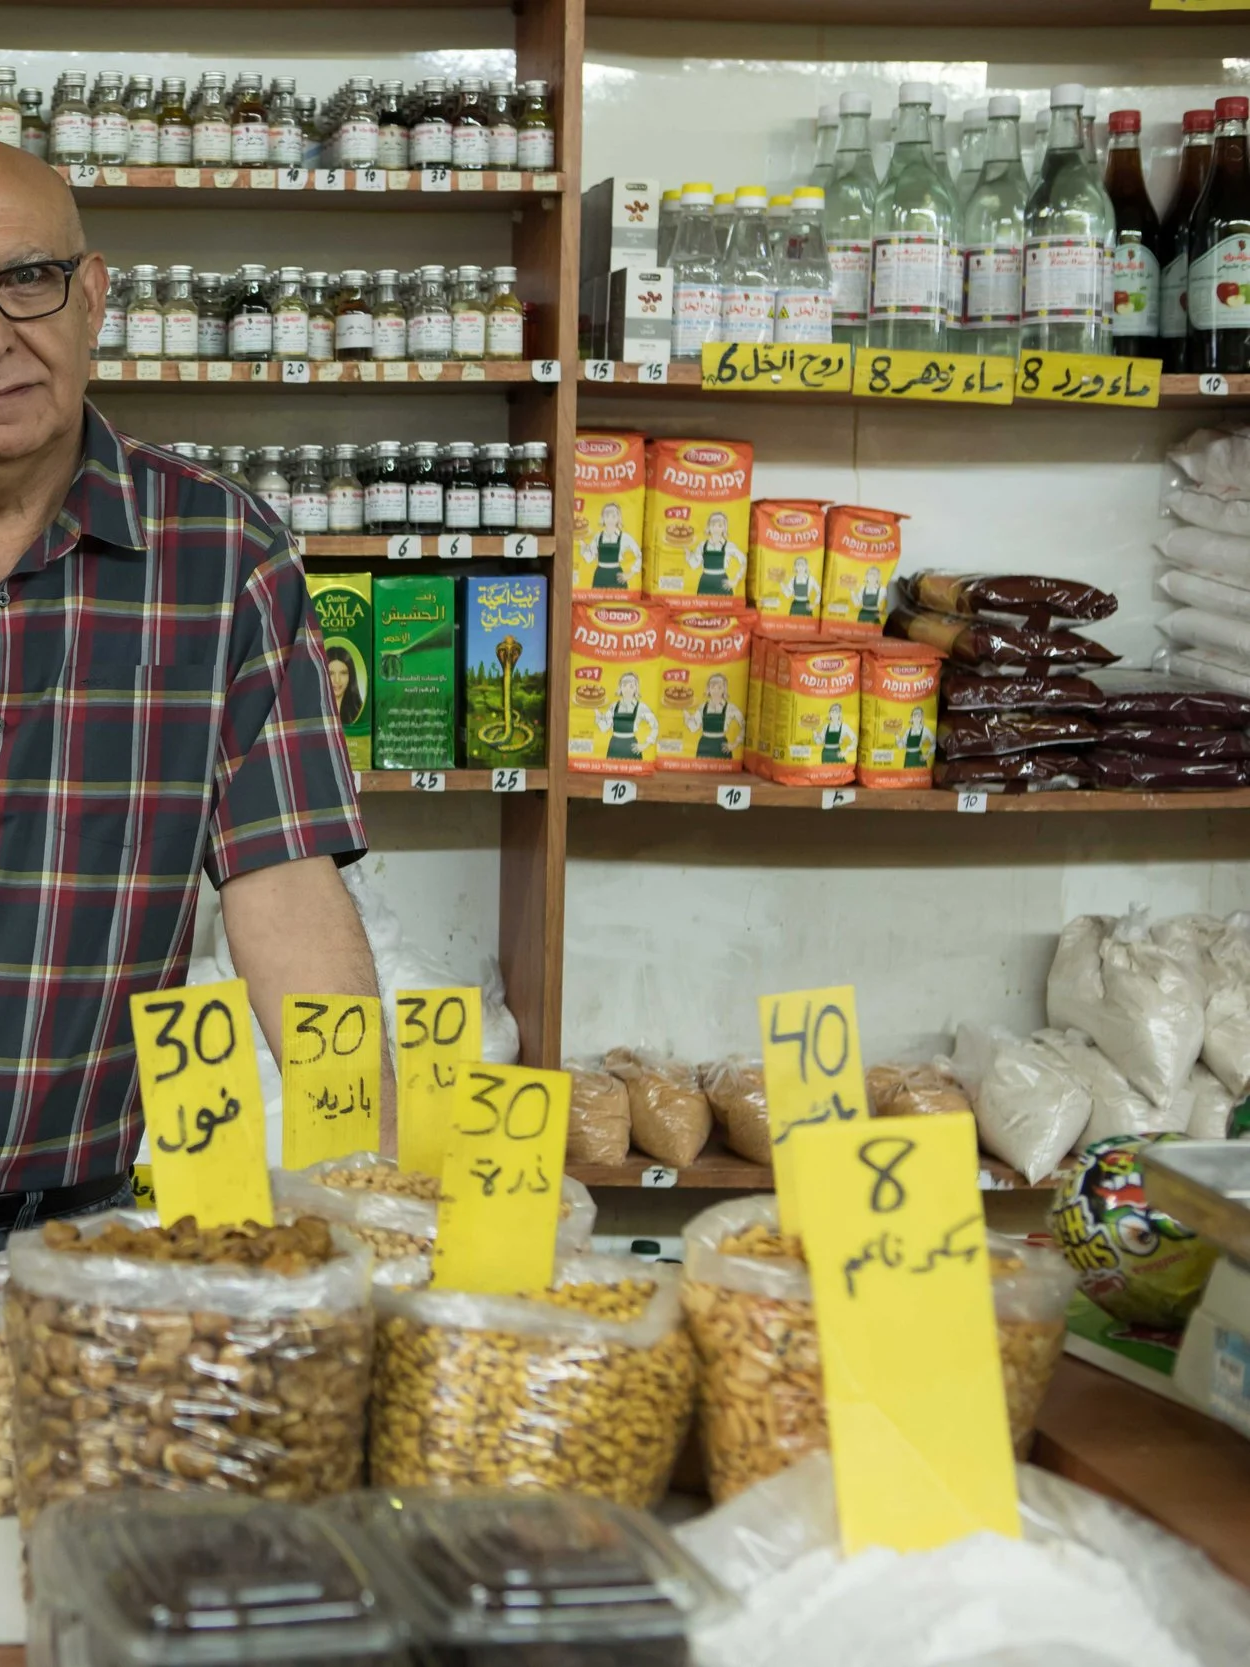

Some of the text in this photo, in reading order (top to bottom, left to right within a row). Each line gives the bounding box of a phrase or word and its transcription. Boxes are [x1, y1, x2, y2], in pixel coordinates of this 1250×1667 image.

[78, 165, 95, 177] 20
[287, 363, 303, 376] 20
[593, 363, 609, 380] 15
[647, 363, 662, 380] 15
[717, 342, 738, 382] 6
[800, 354, 844, 387] روح
[869, 356, 1003, 394] ماء زهر 8
[1021, 357, 1150, 399] ماء ورد 8
[1206, 376, 1221, 392] 10
[575, 460, 637, 481] קמח תופ
[663, 467, 746, 489] קמח תופח
[398, 537, 410, 557] 6
[450, 537, 460, 555] 6
[515, 536, 527, 556] 6
[315, 600, 364, 618] AMLA
[381, 604, 446, 626] الحشيش
[320, 618, 356, 628] GOLD
[574, 626, 657, 649] קמח תופח
[665, 628, 744, 653] קמח תופח
[800, 673, 855, 688] קמח תופח
[414, 771, 439, 789] 25
[494, 771, 519, 790] 25
[611, 783, 627, 801] 10
[726, 788, 741, 806] 10
[962, 795, 978, 808] 10
[289, 1001, 366, 1064] 30
[396, 996, 466, 1049] 30
[144, 999, 236, 1083] 30
[769, 1001, 849, 1084] 40
[459, 1072, 551, 1141] 30
[157, 1087, 241, 1155] فول
[858, 1137, 916, 1214] 8
[910, 1214, 985, 1275] سكر
